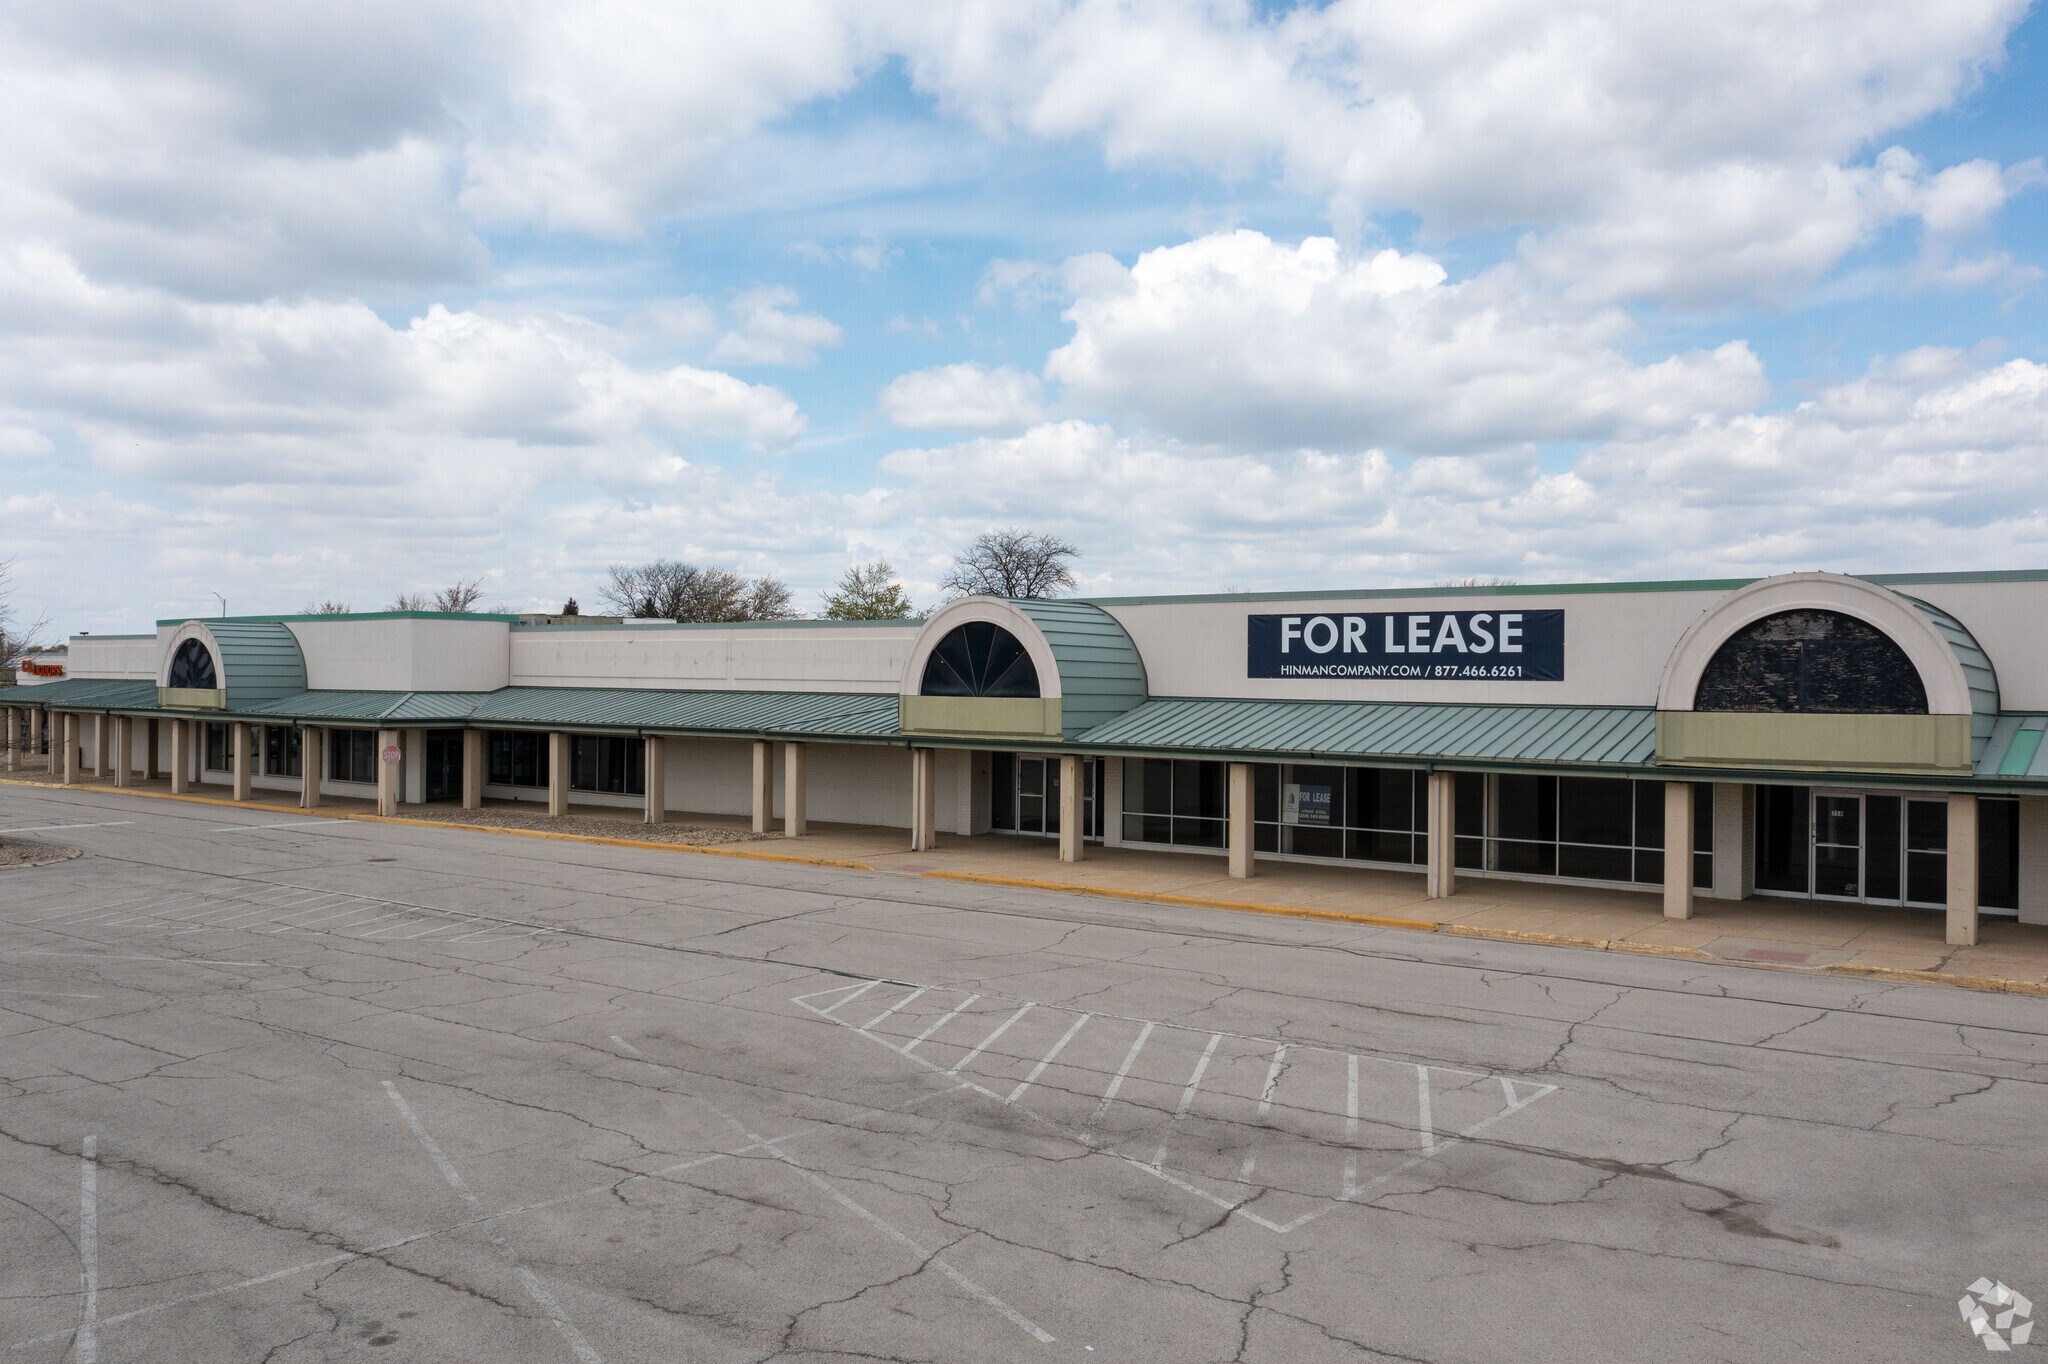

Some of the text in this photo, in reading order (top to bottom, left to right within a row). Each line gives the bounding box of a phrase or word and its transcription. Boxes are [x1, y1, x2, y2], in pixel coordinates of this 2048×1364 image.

[1281, 613, 1523, 654] FOR LEASE
[33, 665, 63, 677] LIQUORS
[1281, 665, 1522, 678] HINMANCOMPANY.COM / 877.466.6261
[383, 751, 400, 759] STOP
[1300, 792, 1330, 802] FOR LEASE
